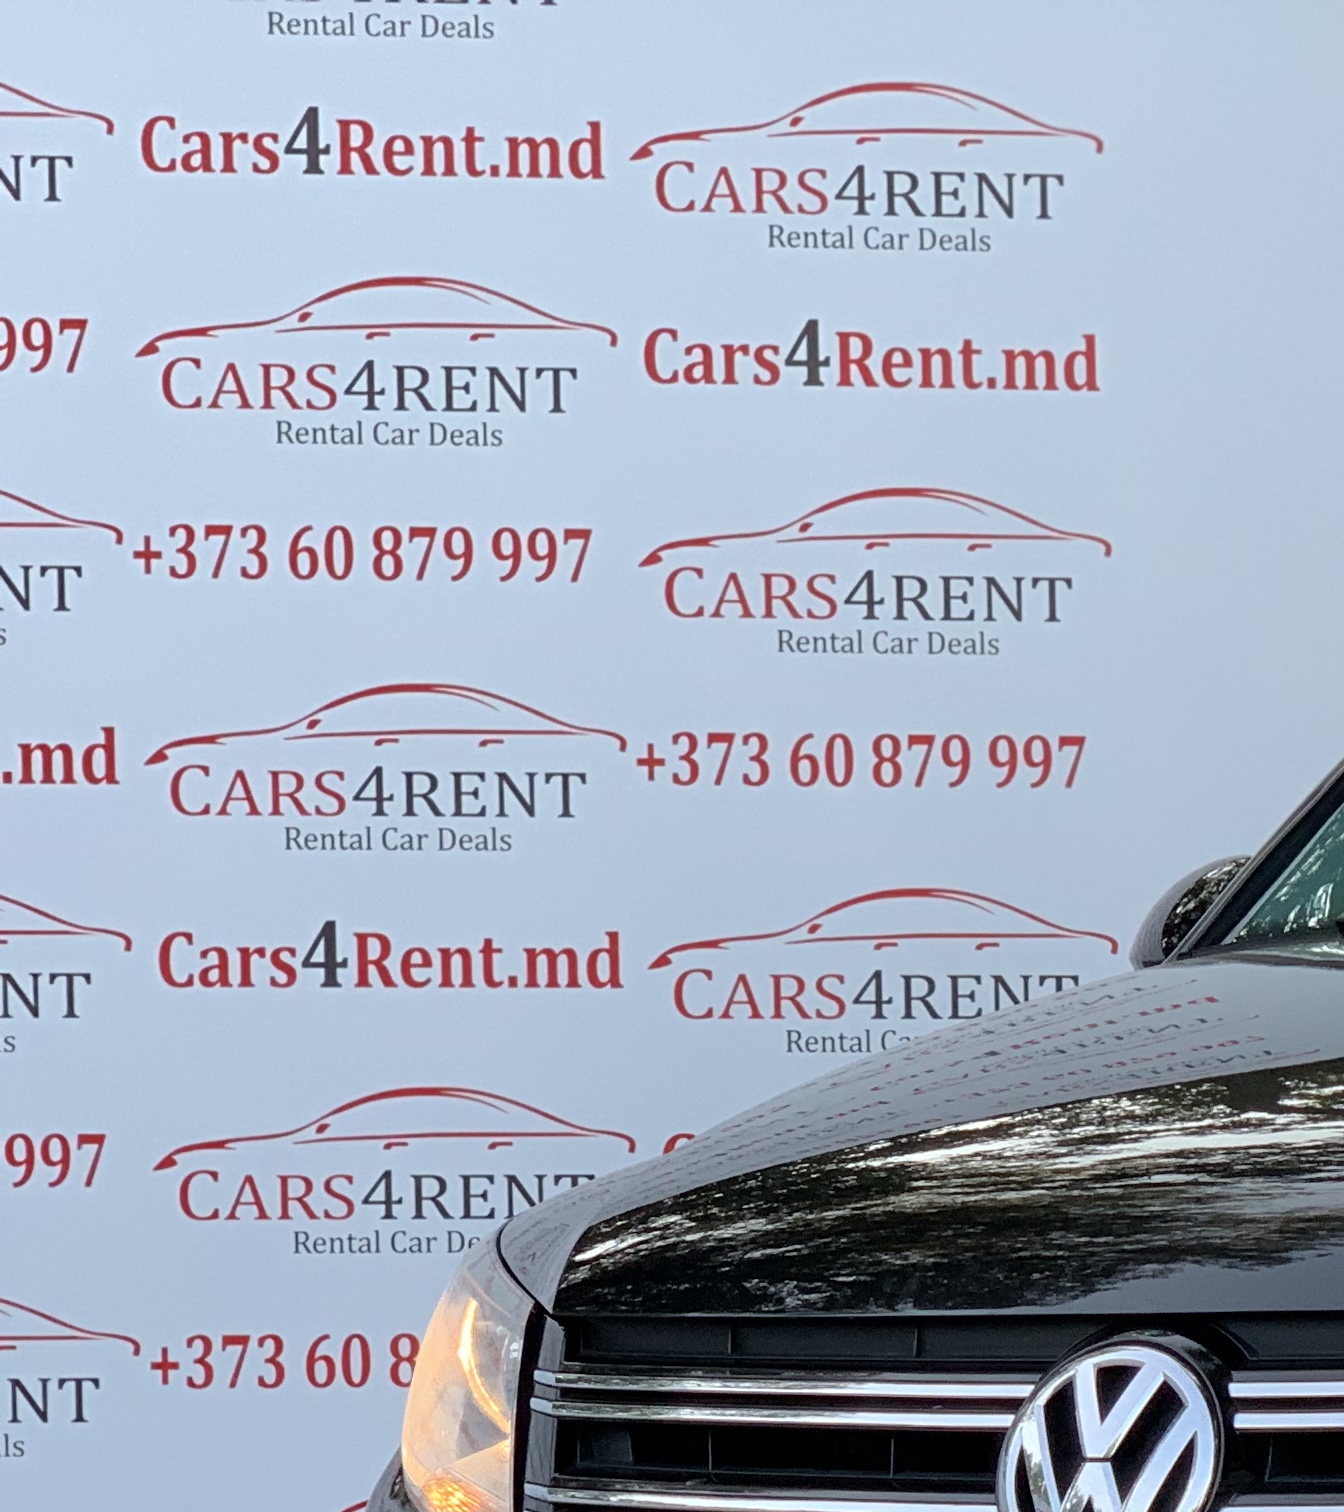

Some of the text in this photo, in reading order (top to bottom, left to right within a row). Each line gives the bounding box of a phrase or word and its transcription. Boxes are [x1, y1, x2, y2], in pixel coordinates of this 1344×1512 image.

[268, 11, 494, 39] Rental Car Deals
[141, 107, 605, 179] Cars4Rent.md
[656, 161, 1064, 220] CARS4RENT
[769, 225, 990, 252] Rental Car Deals
[644, 319, 1100, 391] Cars4Rent.md
[162, 357, 577, 413] CARS4RENT
[277, 420, 502, 447] Rental Car Deals
[133, 524, 592, 582] +373 60 879 997
[665, 567, 1072, 622] CARS4RENT
[778, 630, 999, 655] Rental Car Deals
[637, 732, 1086, 788] +373 60 879 997
[171, 765, 586, 817] CARS4RENT
[285, 826, 511, 851] Rental Car Deals
[159, 921, 623, 988] Cars4Rent.md
[787, 1029, 871, 1053] Rental
[5, 1134, 106, 1188] 997
[294, 1230, 380, 1253] Rental
[391, 1231, 437, 1253] Car
[151, 1334, 285, 1389] +373
[306, 1334, 370, 1388] 60
